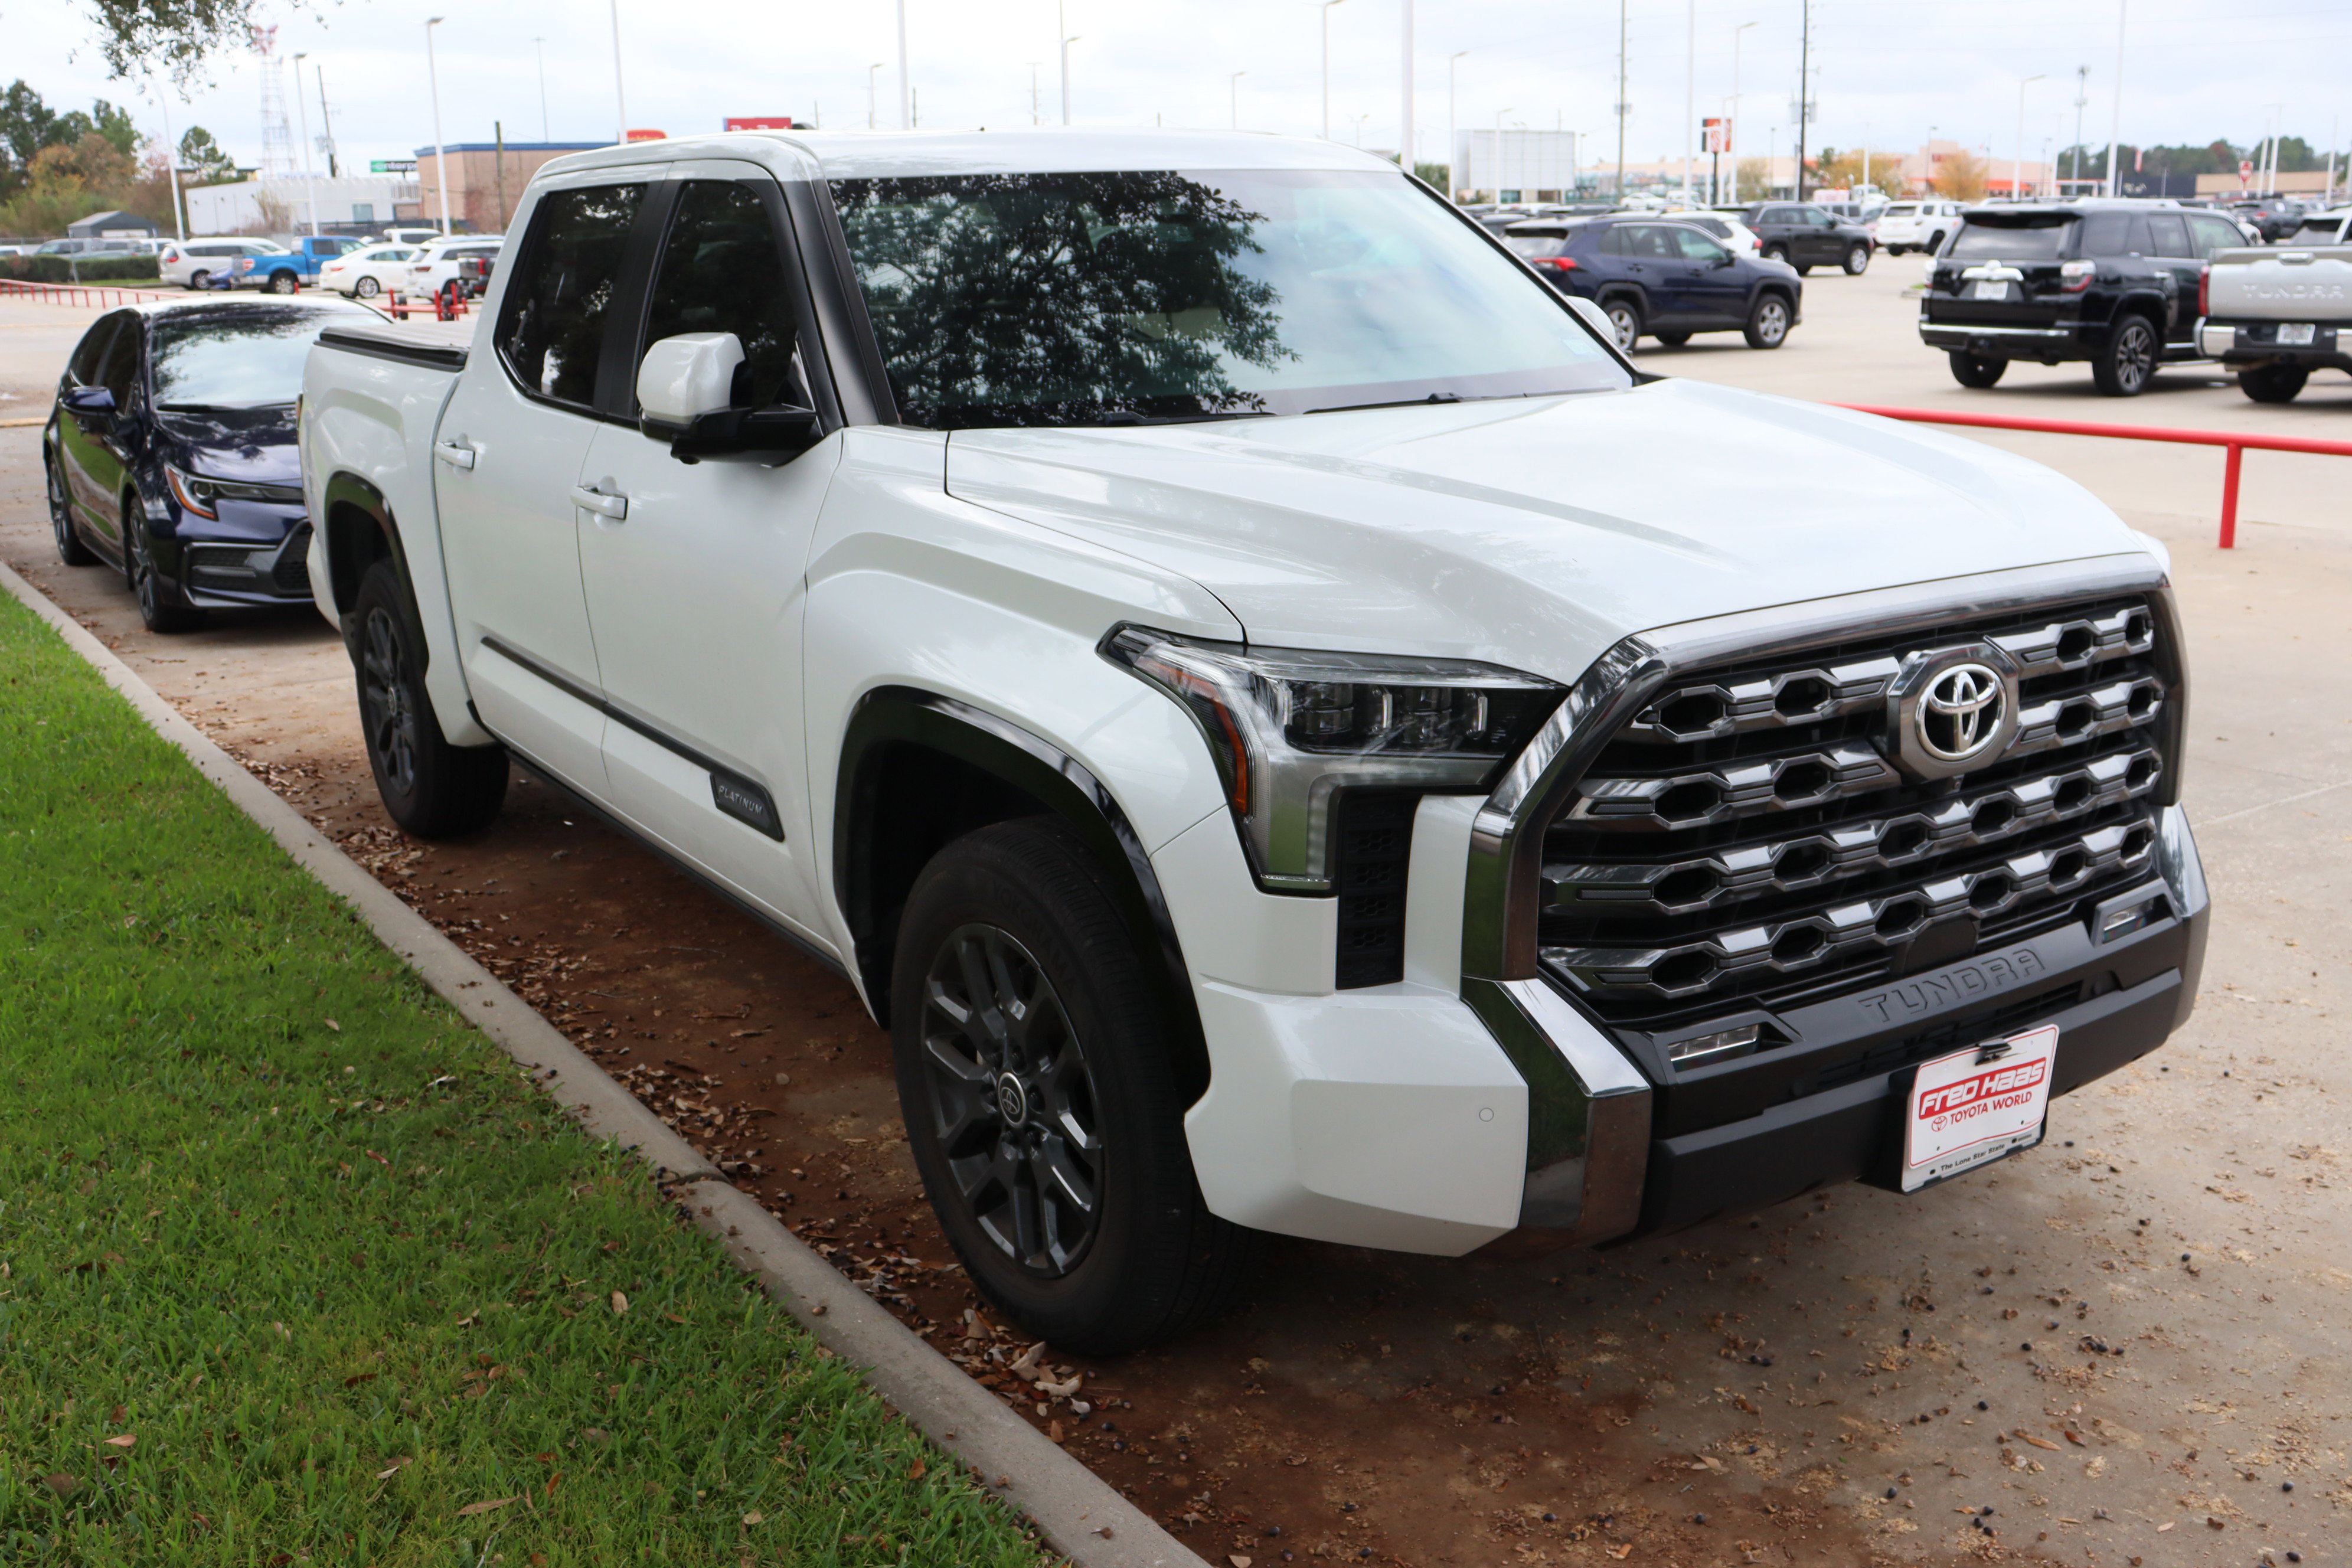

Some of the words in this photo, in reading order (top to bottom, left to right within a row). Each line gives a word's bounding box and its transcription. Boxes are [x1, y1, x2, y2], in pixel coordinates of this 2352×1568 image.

[2243, 284, 2344, 299] TUNDRA
[718, 785, 764, 815] PLATINUM
[1858, 948, 2046, 1023] TUNDRA
[1950, 1102, 1988, 1125] TOYOTA
[1992, 1091, 2033, 1112] WORLD
[1955, 1157, 1971, 1167] Lone
[1973, 1151, 1987, 1160] Star
[1988, 1144, 2005, 1154] State
